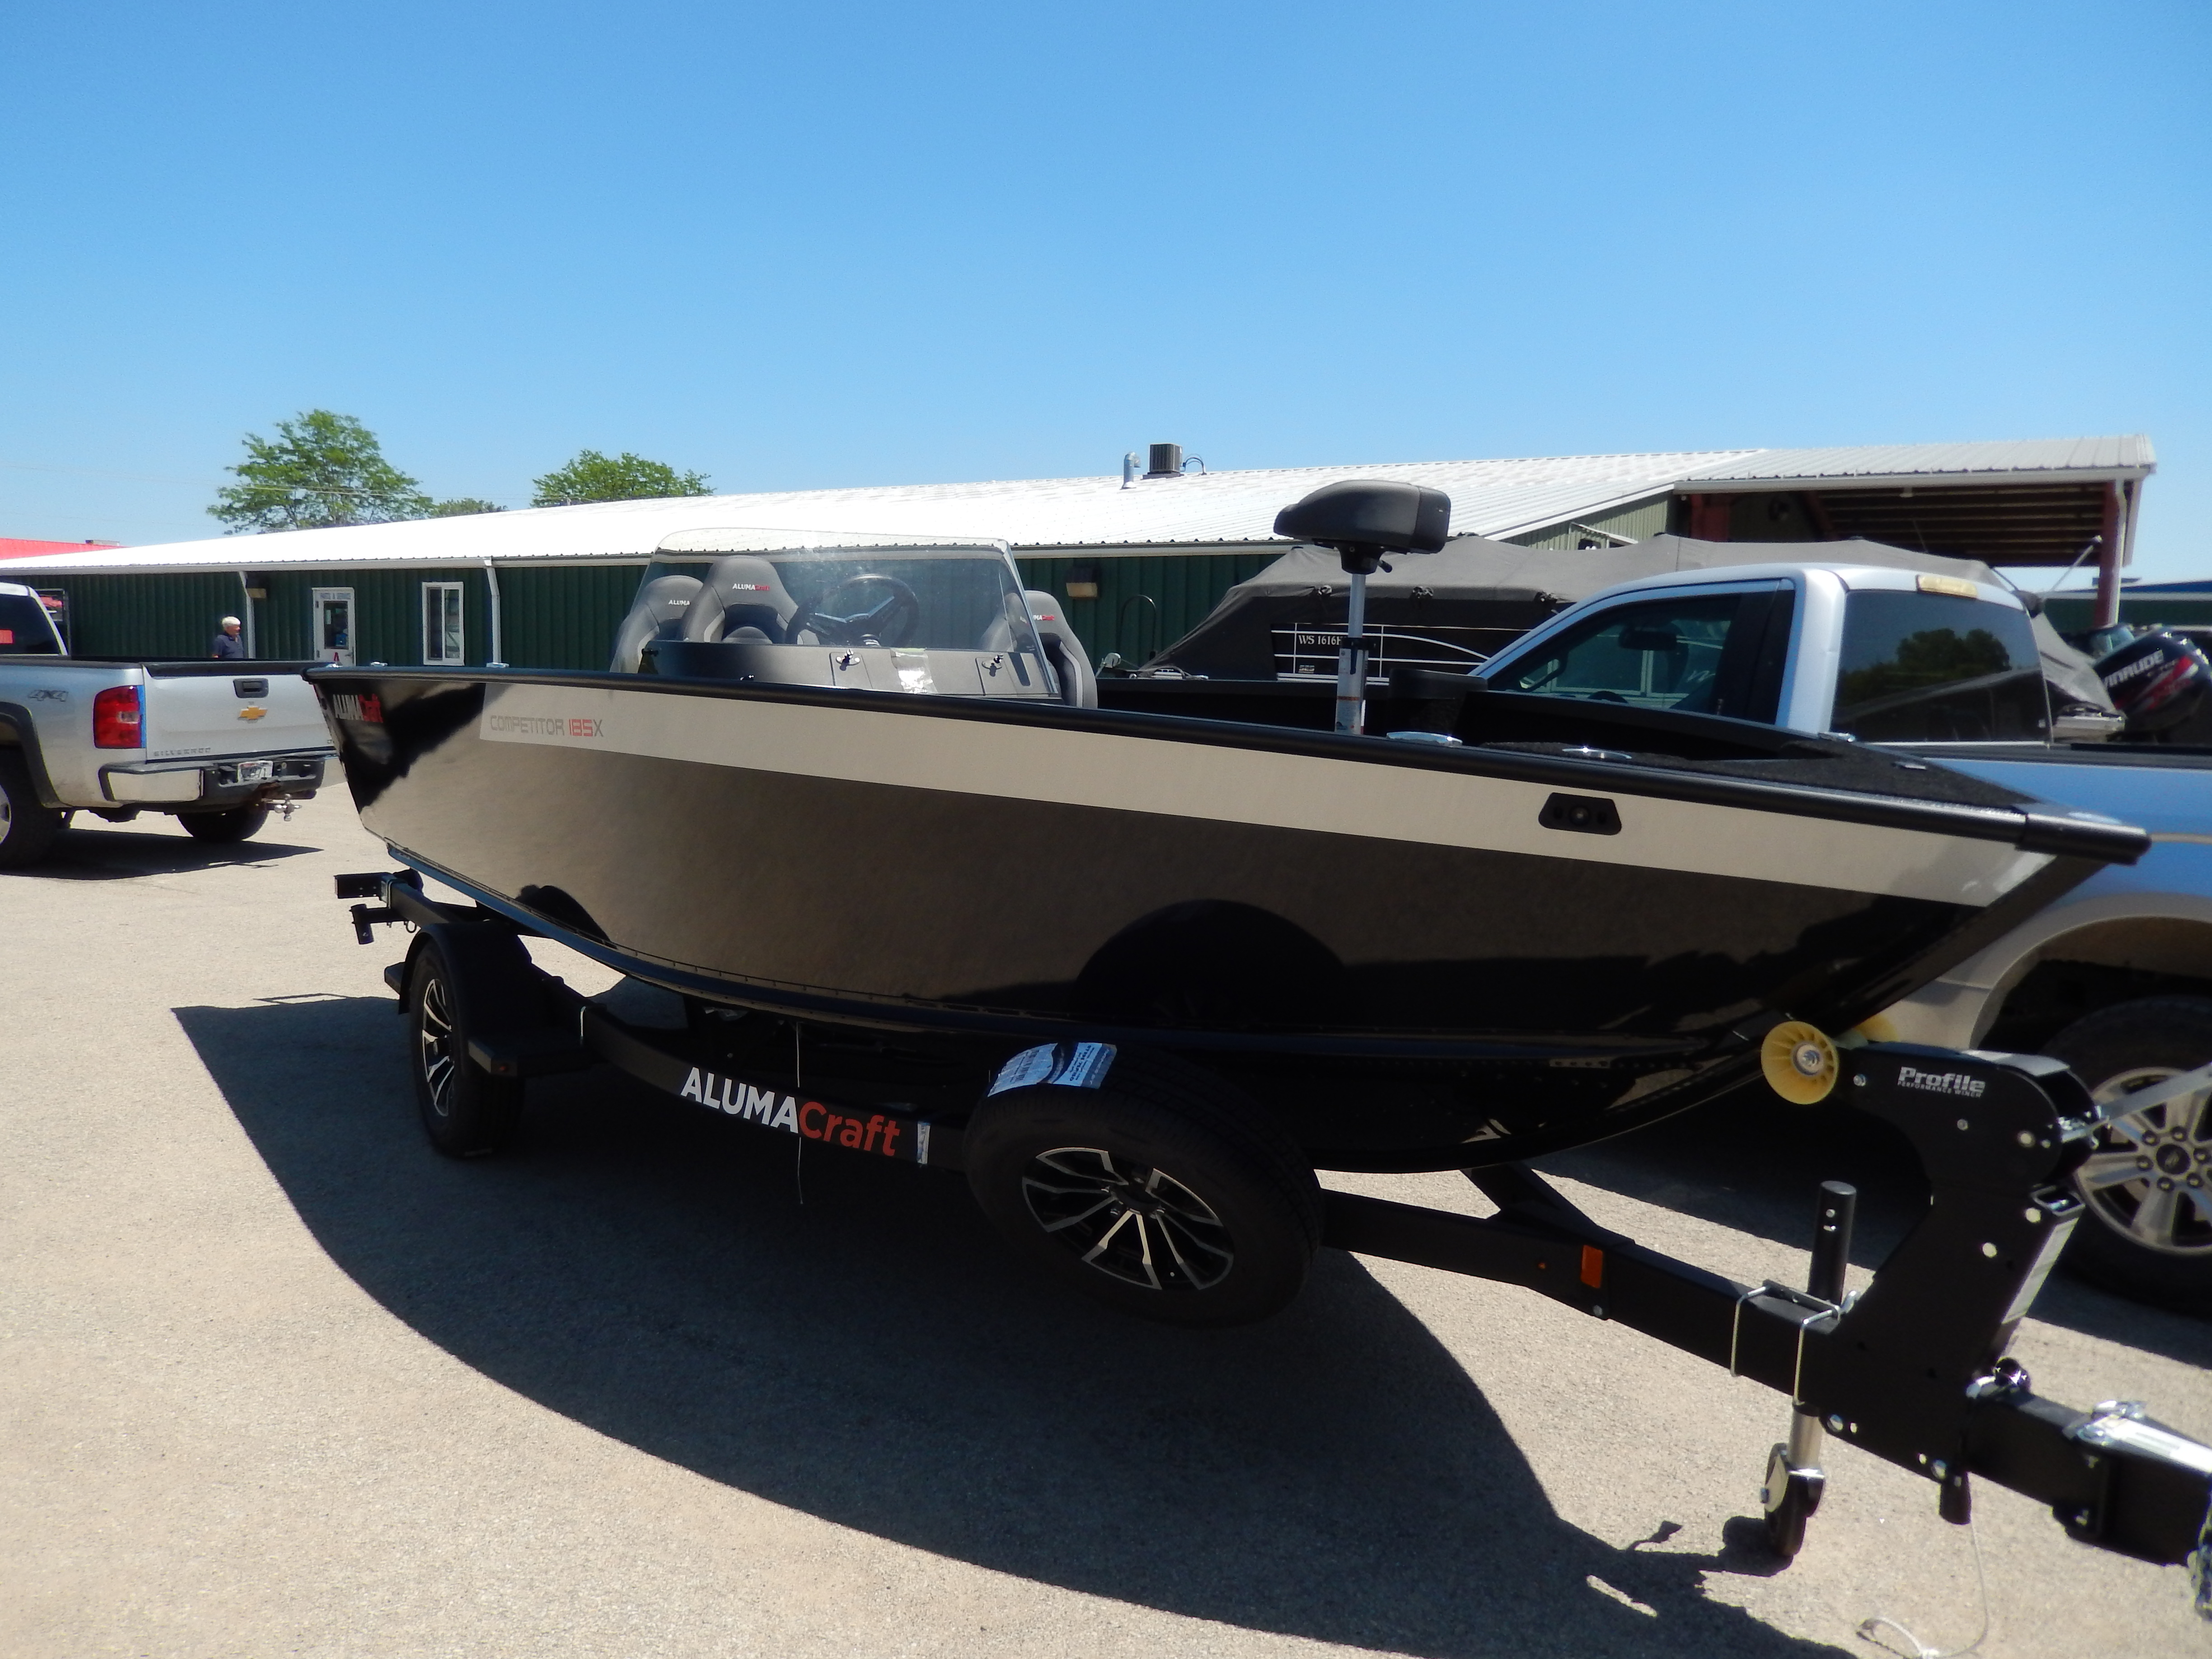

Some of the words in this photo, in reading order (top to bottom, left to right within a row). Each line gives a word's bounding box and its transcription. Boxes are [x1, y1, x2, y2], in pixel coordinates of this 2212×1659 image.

[1298, 635, 1315, 645] WS
[1318, 635, 1345, 646] 1616H
[490, 715, 564, 736] COMPETITOR
[1898, 1066, 1986, 1093] Profile
[680, 1067, 900, 1157] ALUMACraft
